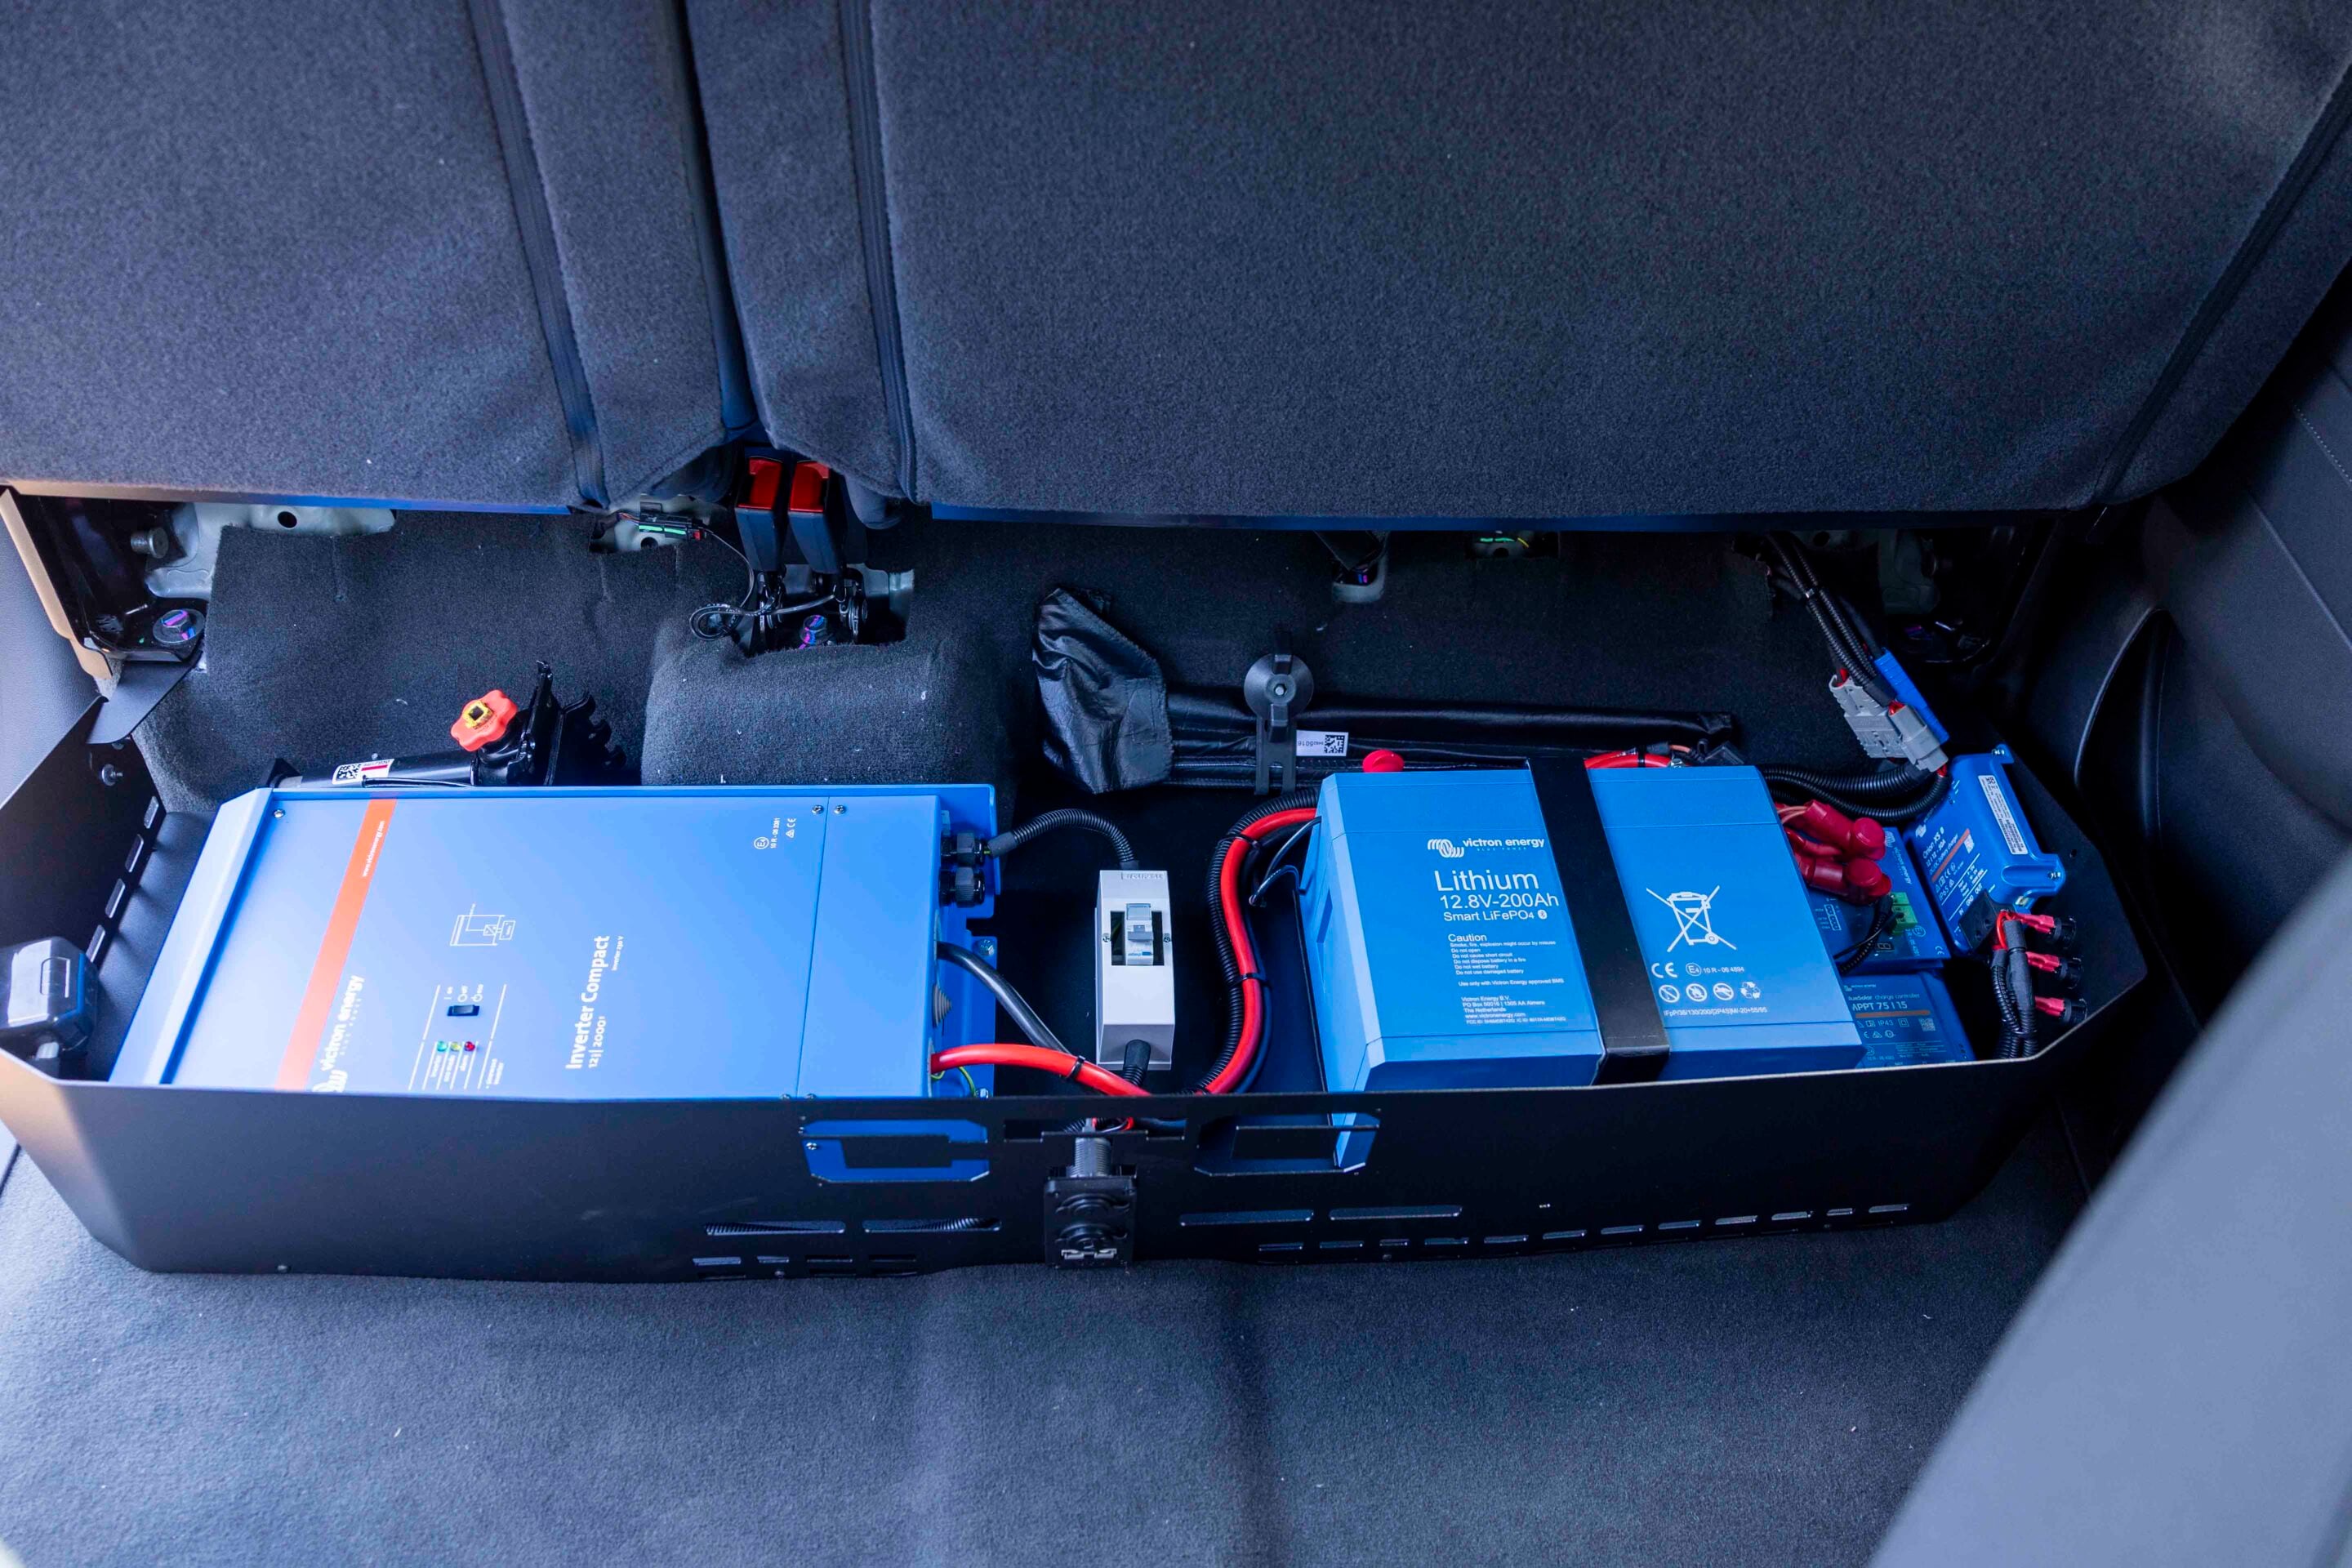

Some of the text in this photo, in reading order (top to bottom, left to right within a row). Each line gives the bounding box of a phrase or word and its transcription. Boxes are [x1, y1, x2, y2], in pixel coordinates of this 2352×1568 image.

[1462, 838, 1544, 848] victron energy
[1434, 869, 1539, 891] Lithium
[1440, 892, 1559, 909] 12.8V-200Ah
[1939, 887, 1949, 901] IP65
[1443, 910, 1535, 921] Smart LiFePO4
[565, 935, 610, 1069] Inverter Compact
[1876, 1002, 1889, 1010] 75
[320, 1024, 347, 1071] victron
[337, 975, 365, 1021] energy
